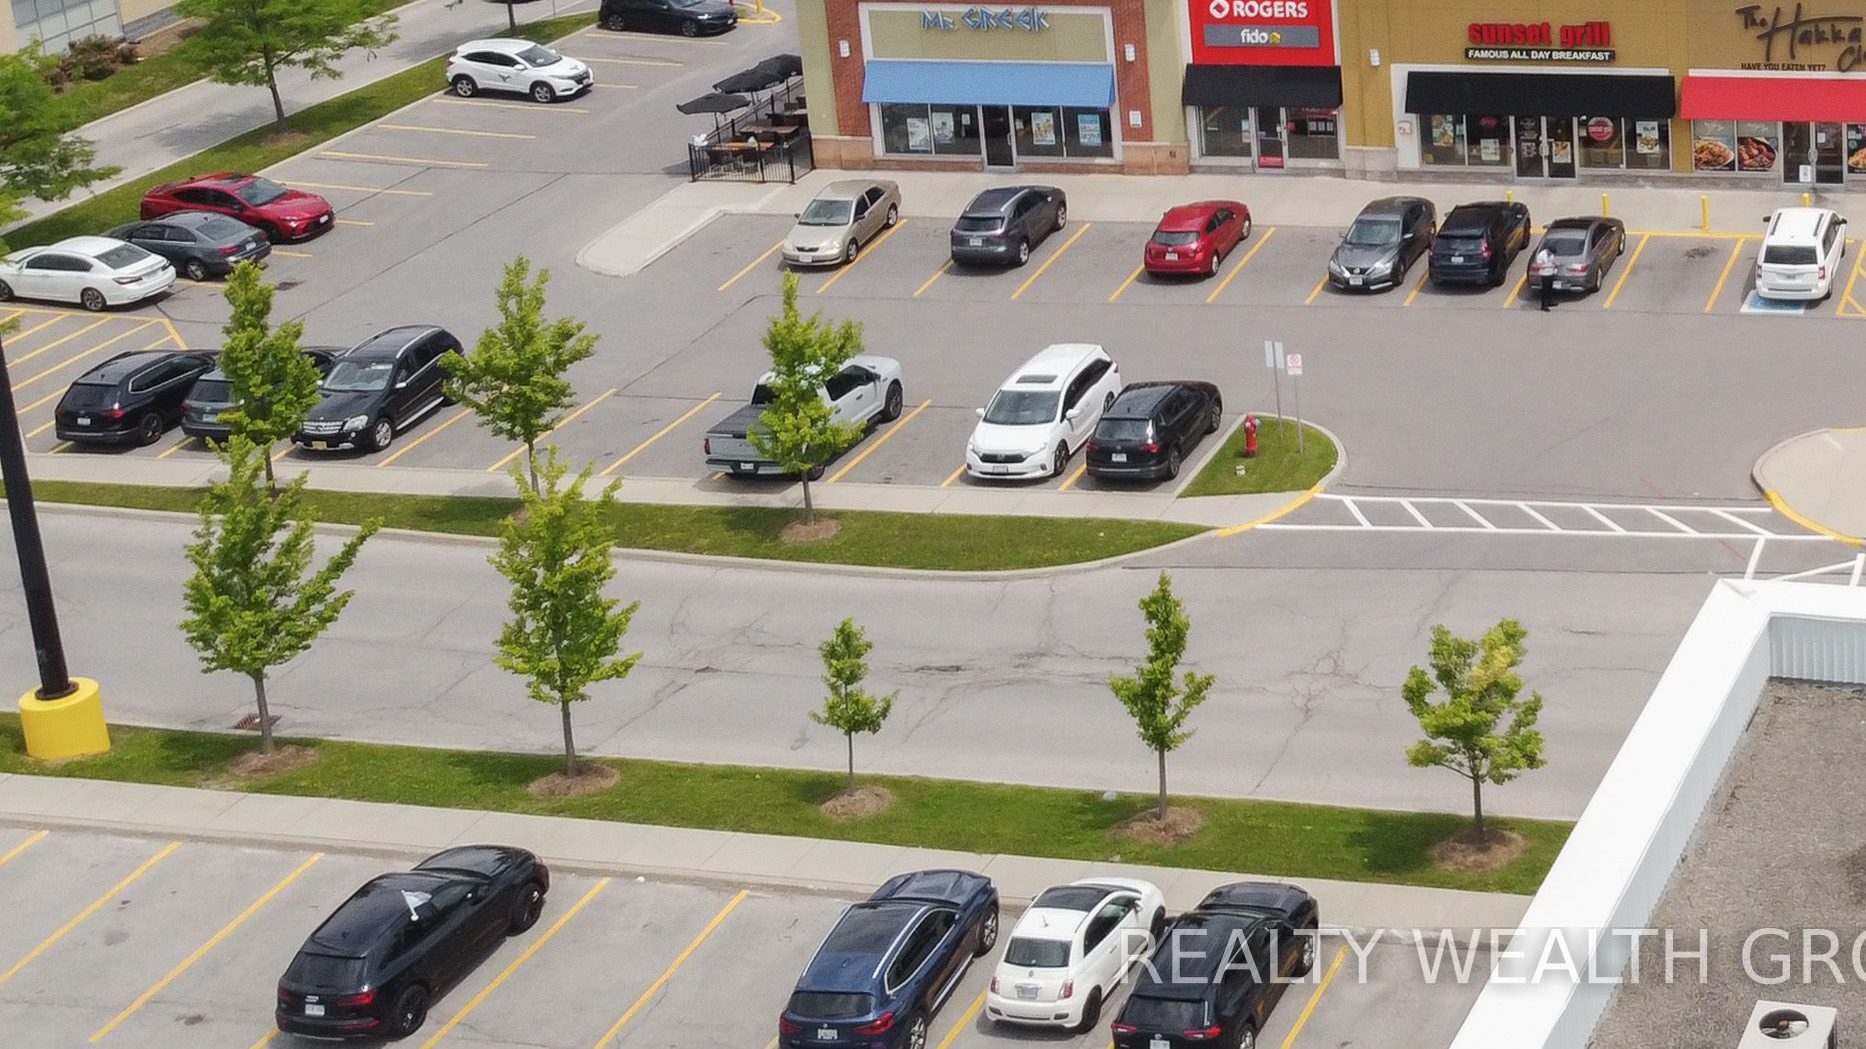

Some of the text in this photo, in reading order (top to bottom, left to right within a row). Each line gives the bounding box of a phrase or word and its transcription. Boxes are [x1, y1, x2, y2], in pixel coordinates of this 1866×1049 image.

[961, 6, 1049, 32] GREEK
[1232, 0, 1308, 18] ROGERS
[1736, 4, 1768, 29] The
[1240, 28, 1268, 43] fido
[1468, 21, 1610, 48] sunset grill
[1756, 2, 1863, 62] Hakka
[1468, 50, 1610, 61] FAMOUS ALL DAY BREAKFAST
[1741, 62, 1761, 71] HAVE
[1763, 63, 1780, 71] YOU
[1781, 63, 1806, 71] EATEN
